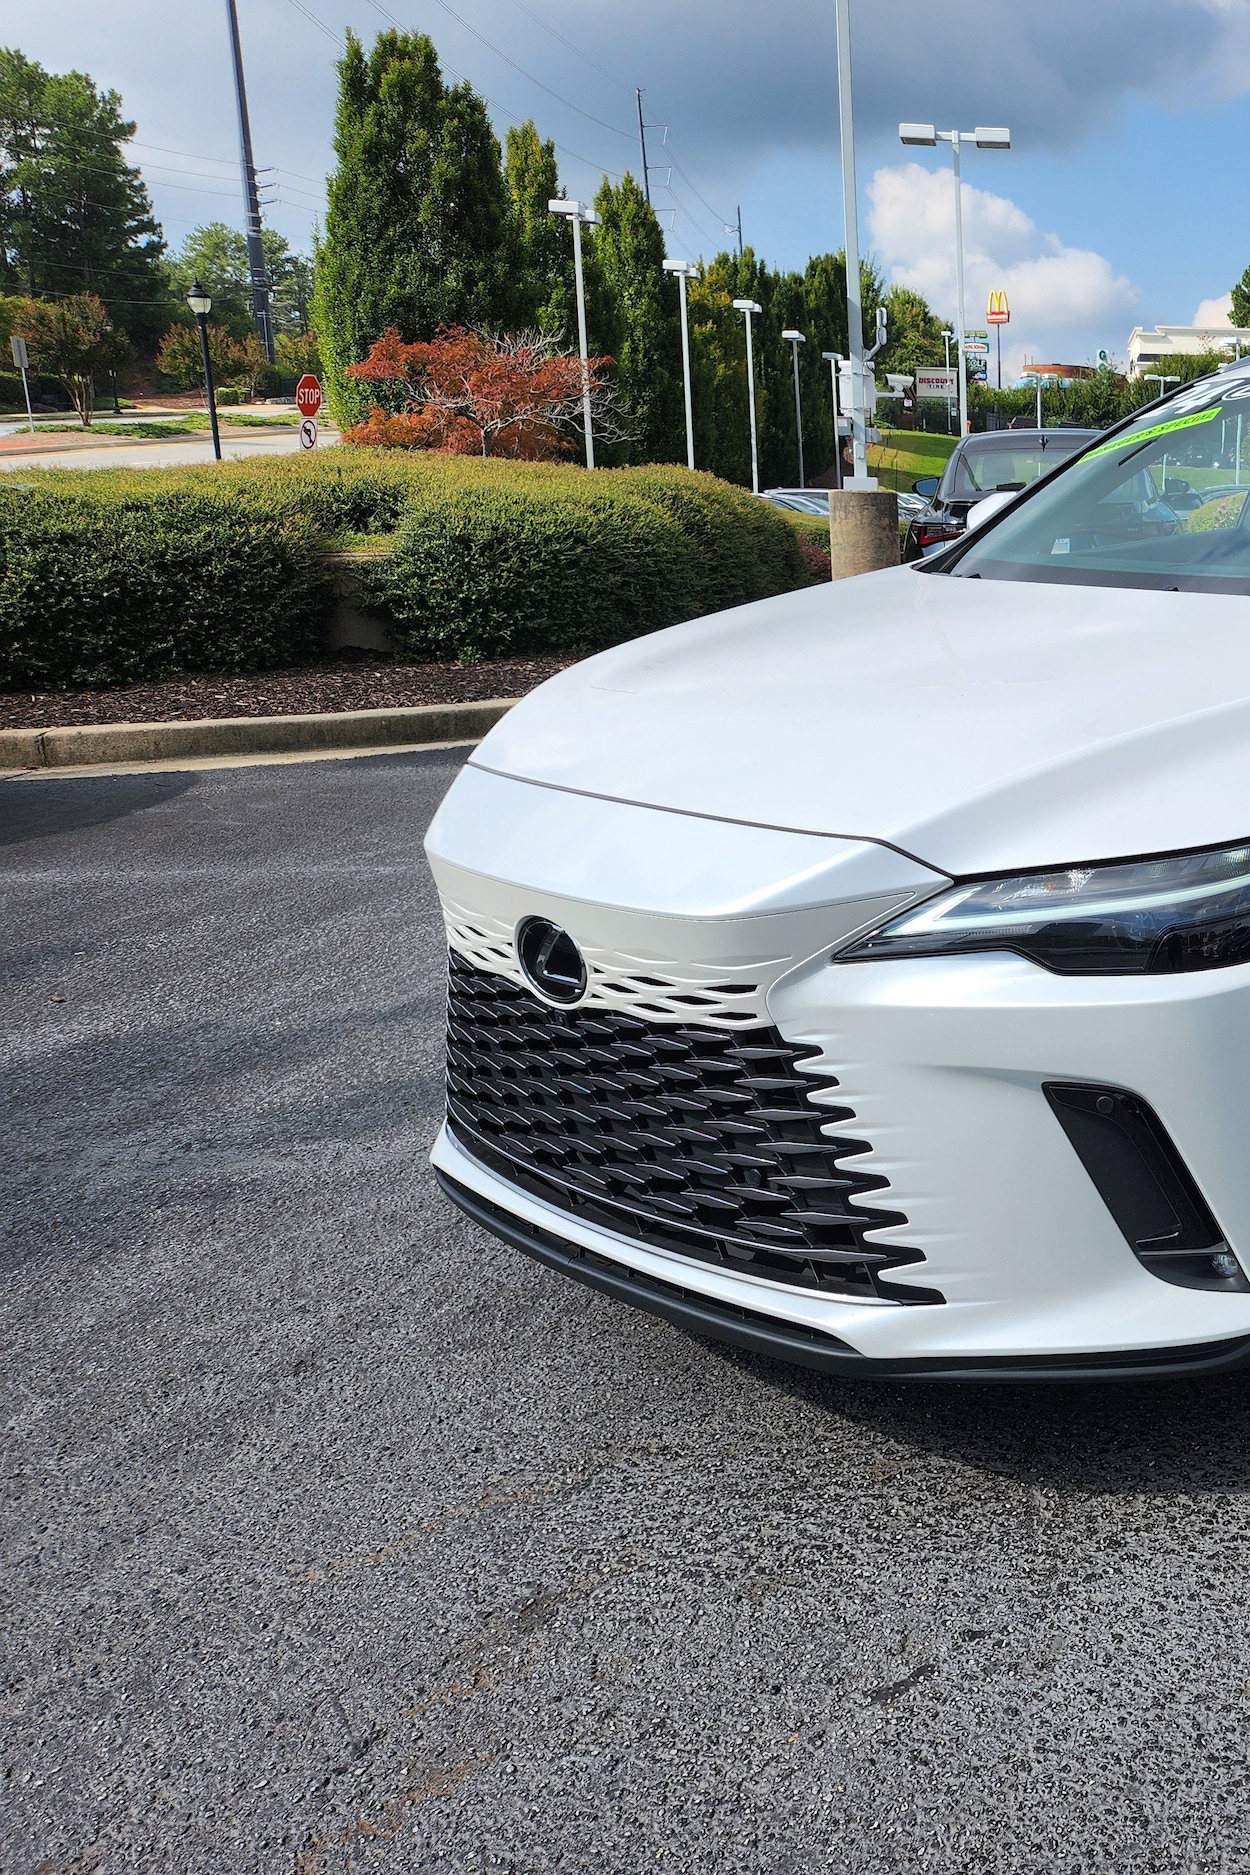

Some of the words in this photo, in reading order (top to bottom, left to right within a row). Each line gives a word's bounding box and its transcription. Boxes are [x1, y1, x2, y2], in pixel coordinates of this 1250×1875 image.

[918, 377, 954, 385] DISCOUT
[298, 388, 320, 405] STOP
[1134, 379, 1245, 421] 24
